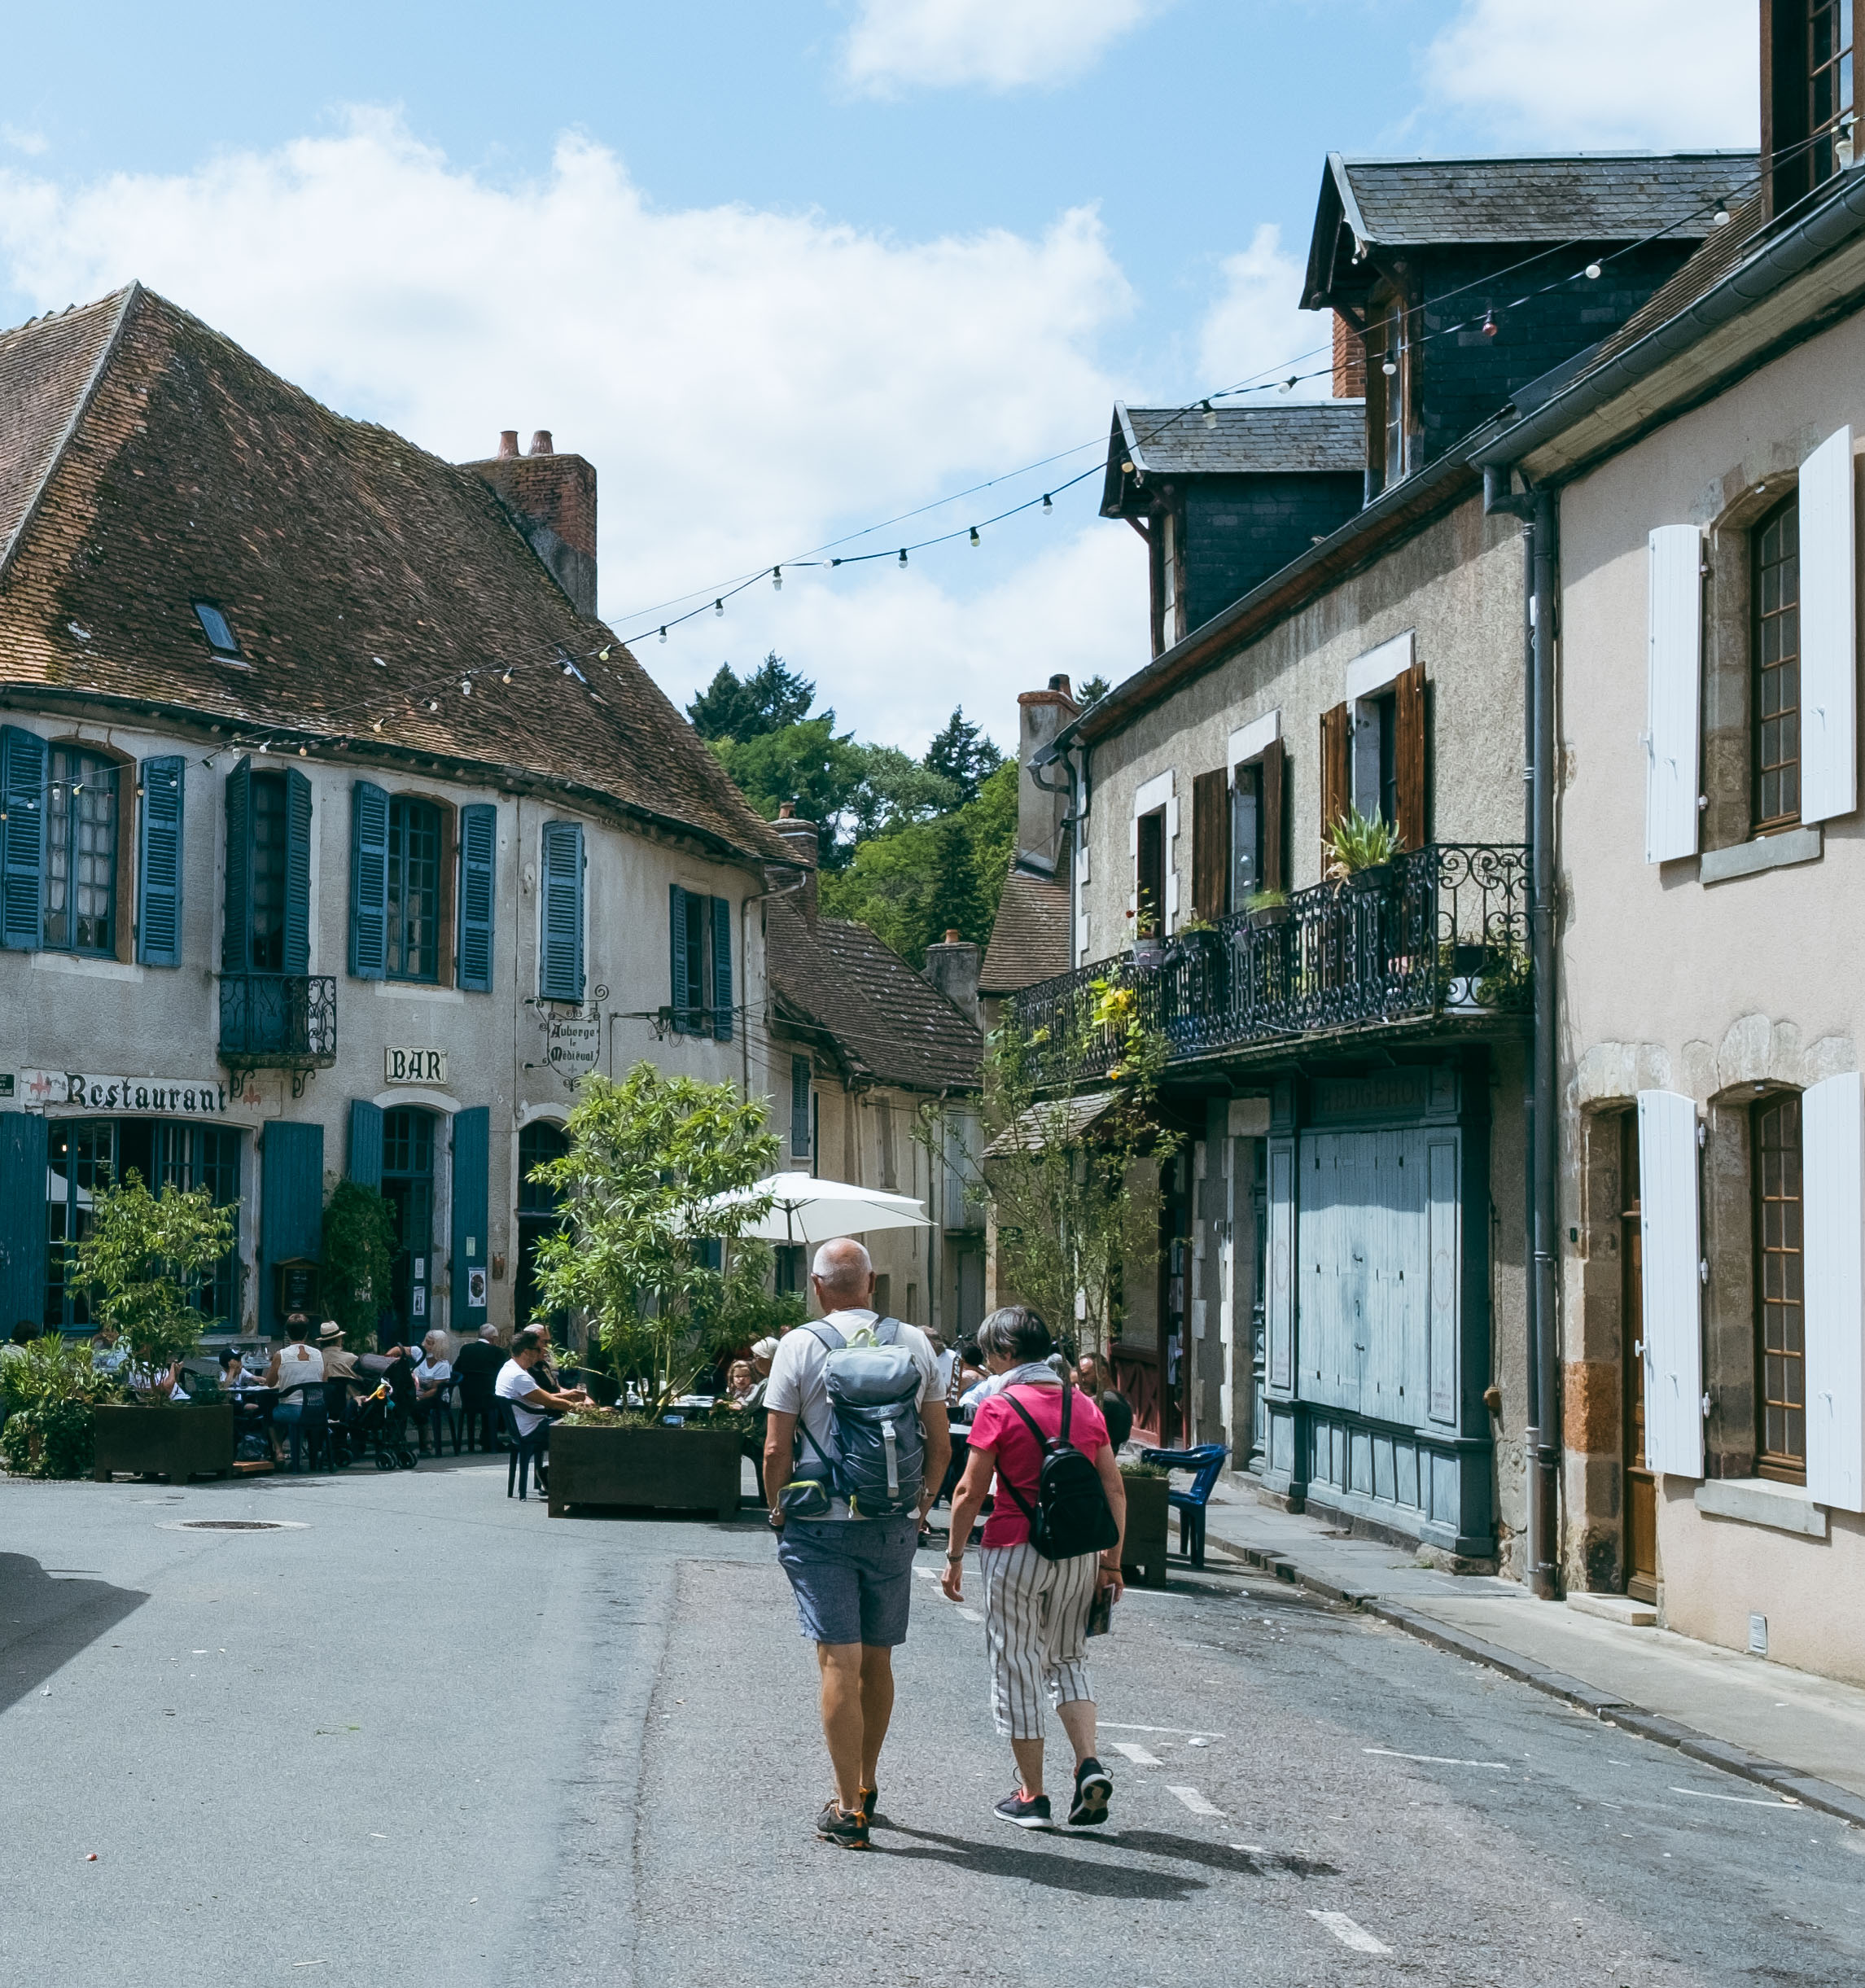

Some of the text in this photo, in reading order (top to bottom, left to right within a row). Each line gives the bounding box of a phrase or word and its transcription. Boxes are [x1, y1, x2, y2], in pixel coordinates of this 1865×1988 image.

[550, 1022, 594, 1040] Auberge
[569, 1038, 576, 1047] le
[392, 1050, 441, 1080] BAR
[64, 1071, 226, 1113] Restaurant
